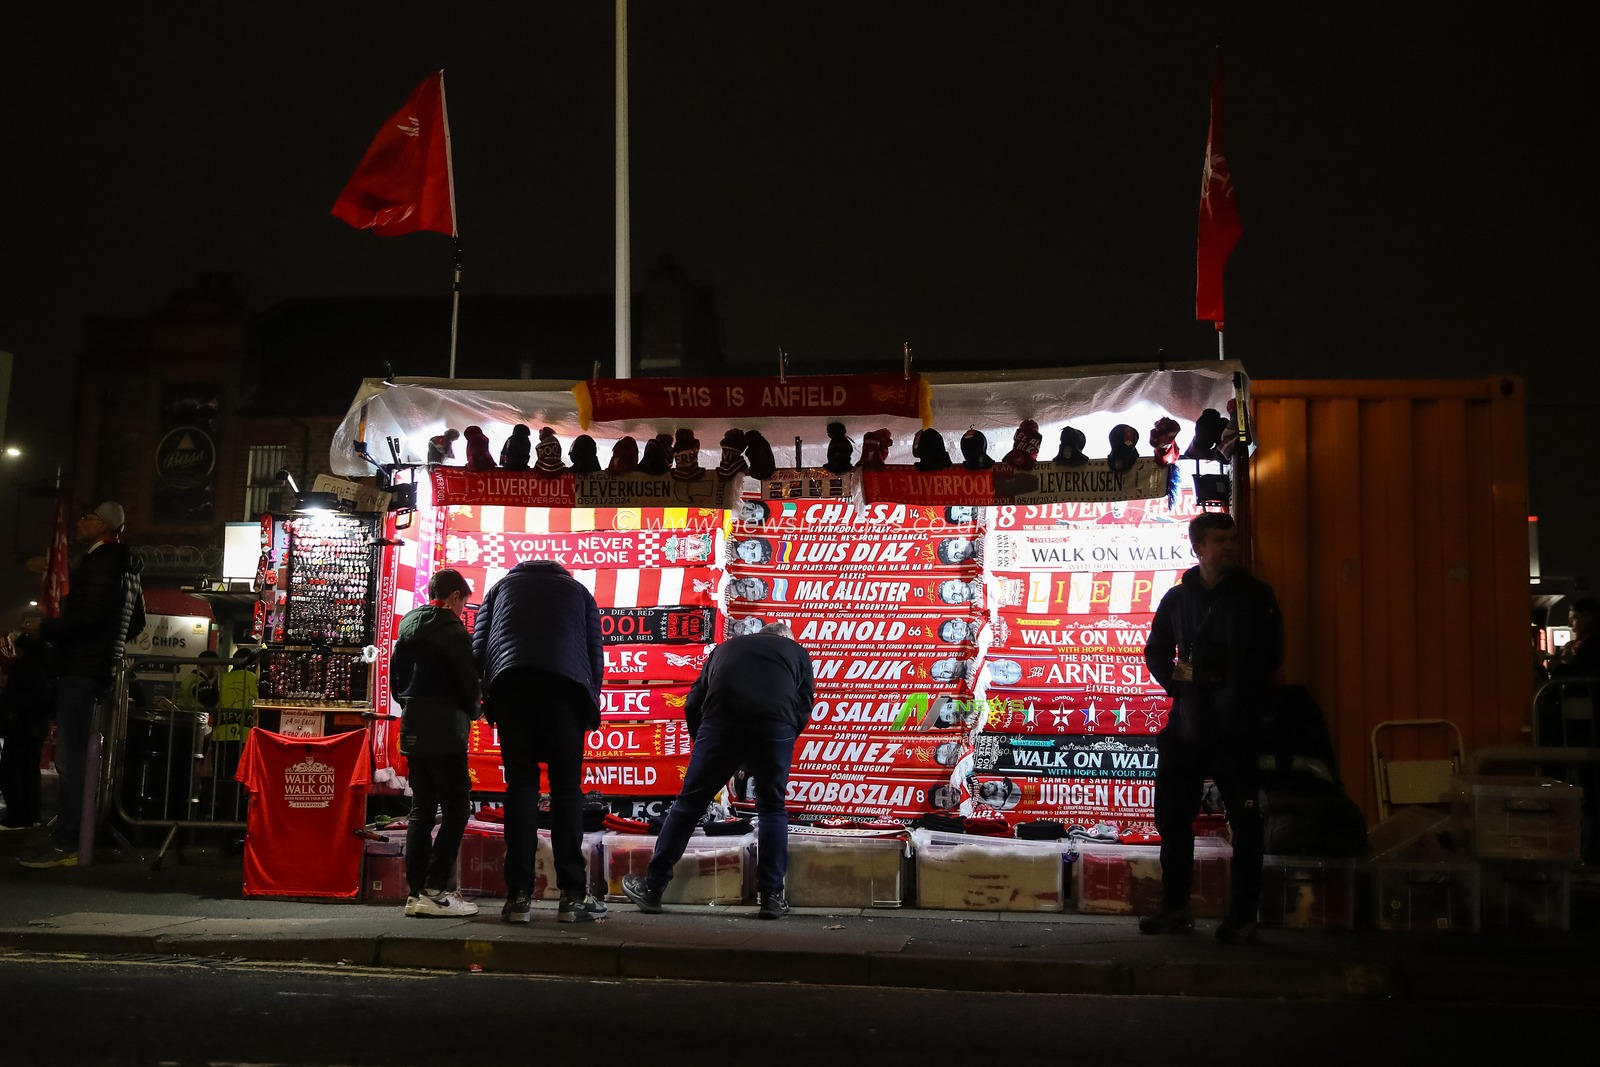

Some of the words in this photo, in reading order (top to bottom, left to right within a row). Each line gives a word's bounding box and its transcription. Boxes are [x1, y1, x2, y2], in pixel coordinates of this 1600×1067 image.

[664, 386, 711, 406] THIS
[726, 385, 744, 406] IS
[761, 386, 847, 408] ANFIELD
[487, 478, 569, 497] LIVERPOOL
[581, 480, 671, 498] LEVERKUSEN
[908, 475, 995, 496] LIVERPOOL
[1039, 471, 1124, 494] LEVERKUSEN
[805, 504, 906, 524] CHIESA
[909, 509, 919, 519] 14
[1025, 501, 1106, 519] STEVEN
[509, 538, 572, 552] YOU'LL
[578, 537, 635, 550] NEVER
[795, 543, 851, 563] LUIS
[851, 542, 915, 562] DIAZ
[914, 547, 921, 557] 7
[515, 552, 566, 564] WALK
[571, 551, 629, 564] ALONE
[1032, 547, 1084, 563] WALK
[1092, 546, 1118, 561] ON
[1129, 545, 1182, 561] WALK
[794, 581, 834, 601] MAC
[833, 581, 911, 602] ALLISTER
[914, 588, 924, 597] 10
[854, 603, 899, 611] ARGENTINA
[799, 621, 906, 641] ARNOLD
[907, 627, 922, 637] 66
[1020, 630, 1077, 646] WALK
[1079, 629, 1108, 645] ON
[152, 636, 186, 648] CHIPS
[620, 651, 648, 666] FC
[1059, 655, 1078, 663] THE
[1079, 655, 1114, 663] DUTCH
[844, 660, 911, 680] DIJK
[907, 666, 916, 676] 4
[1045, 664, 1115, 684] ARNE
[1085, 685, 1145, 694] LIVERPOOL
[623, 692, 650, 712] FC
[831, 702, 911, 722] SALAH
[665, 722, 677, 733] ON
[664, 734, 676, 756] WALK
[679, 734, 691, 755] WALK
[834, 733, 868, 741] DARWIN
[799, 741, 903, 763] NUNEZ
[905, 749, 913, 759] 9
[1012, 750, 1069, 768] WALK
[1073, 751, 1101, 768] ON
[285, 775, 316, 784] WALK
[319, 774, 335, 784] ON
[583, 766, 657, 785] ANFIELD
[831, 773, 866, 781] DOMINIK
[1047, 768, 1071, 776] WITH
[1073, 769, 1097, 777] HOPE
[1110, 770, 1136, 778] YOUR
[284, 785, 316, 794] WALK
[319, 784, 335, 794] ON
[784, 781, 915, 806] SZOBOSZLAI
[916, 790, 925, 803] 8
[1037, 783, 1112, 805] JURGEN
[805, 804, 845, 813] LIVERPOOL
[856, 806, 892, 815] HUNGARY
